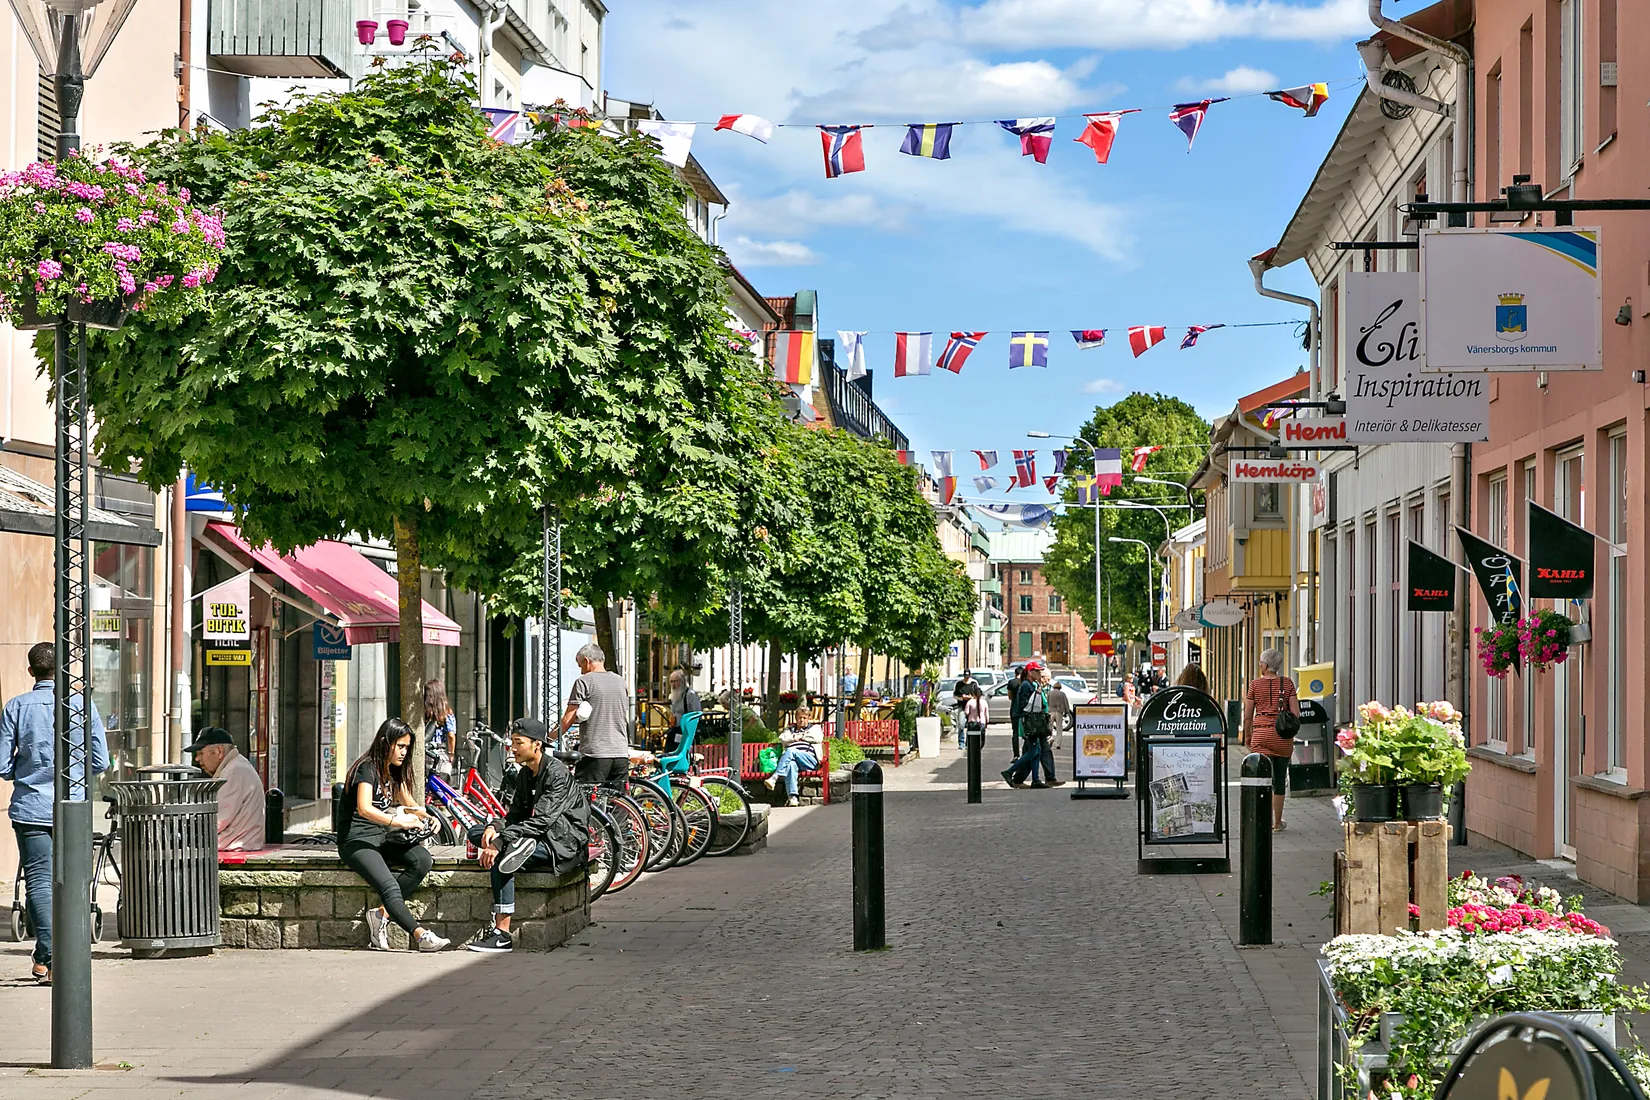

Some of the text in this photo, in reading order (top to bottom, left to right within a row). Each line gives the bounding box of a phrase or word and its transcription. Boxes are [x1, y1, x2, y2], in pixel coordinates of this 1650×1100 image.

[1355, 299, 1419, 367] Eli
[1467, 344, 1557, 355] Vänersborgs kommun
[1354, 372, 1483, 408] Inspiration
[1286, 422, 1346, 441] Hem
[1354, 419, 1483, 433] Interiör & Delikatesser
[1235, 463, 1316, 480] Hemköp
[1537, 567, 1585, 579] KAHLS
[1413, 588, 1449, 597] KAHLS
[1481, 554, 1515, 624] ÖPPE
[210, 603, 243, 617] TUR-
[207, 619, 246, 633] BUTIK
[317, 647, 349, 656] Biljetter
[1163, 691, 1202, 721] Elins
[1156, 720, 1207, 735] Inspiration
